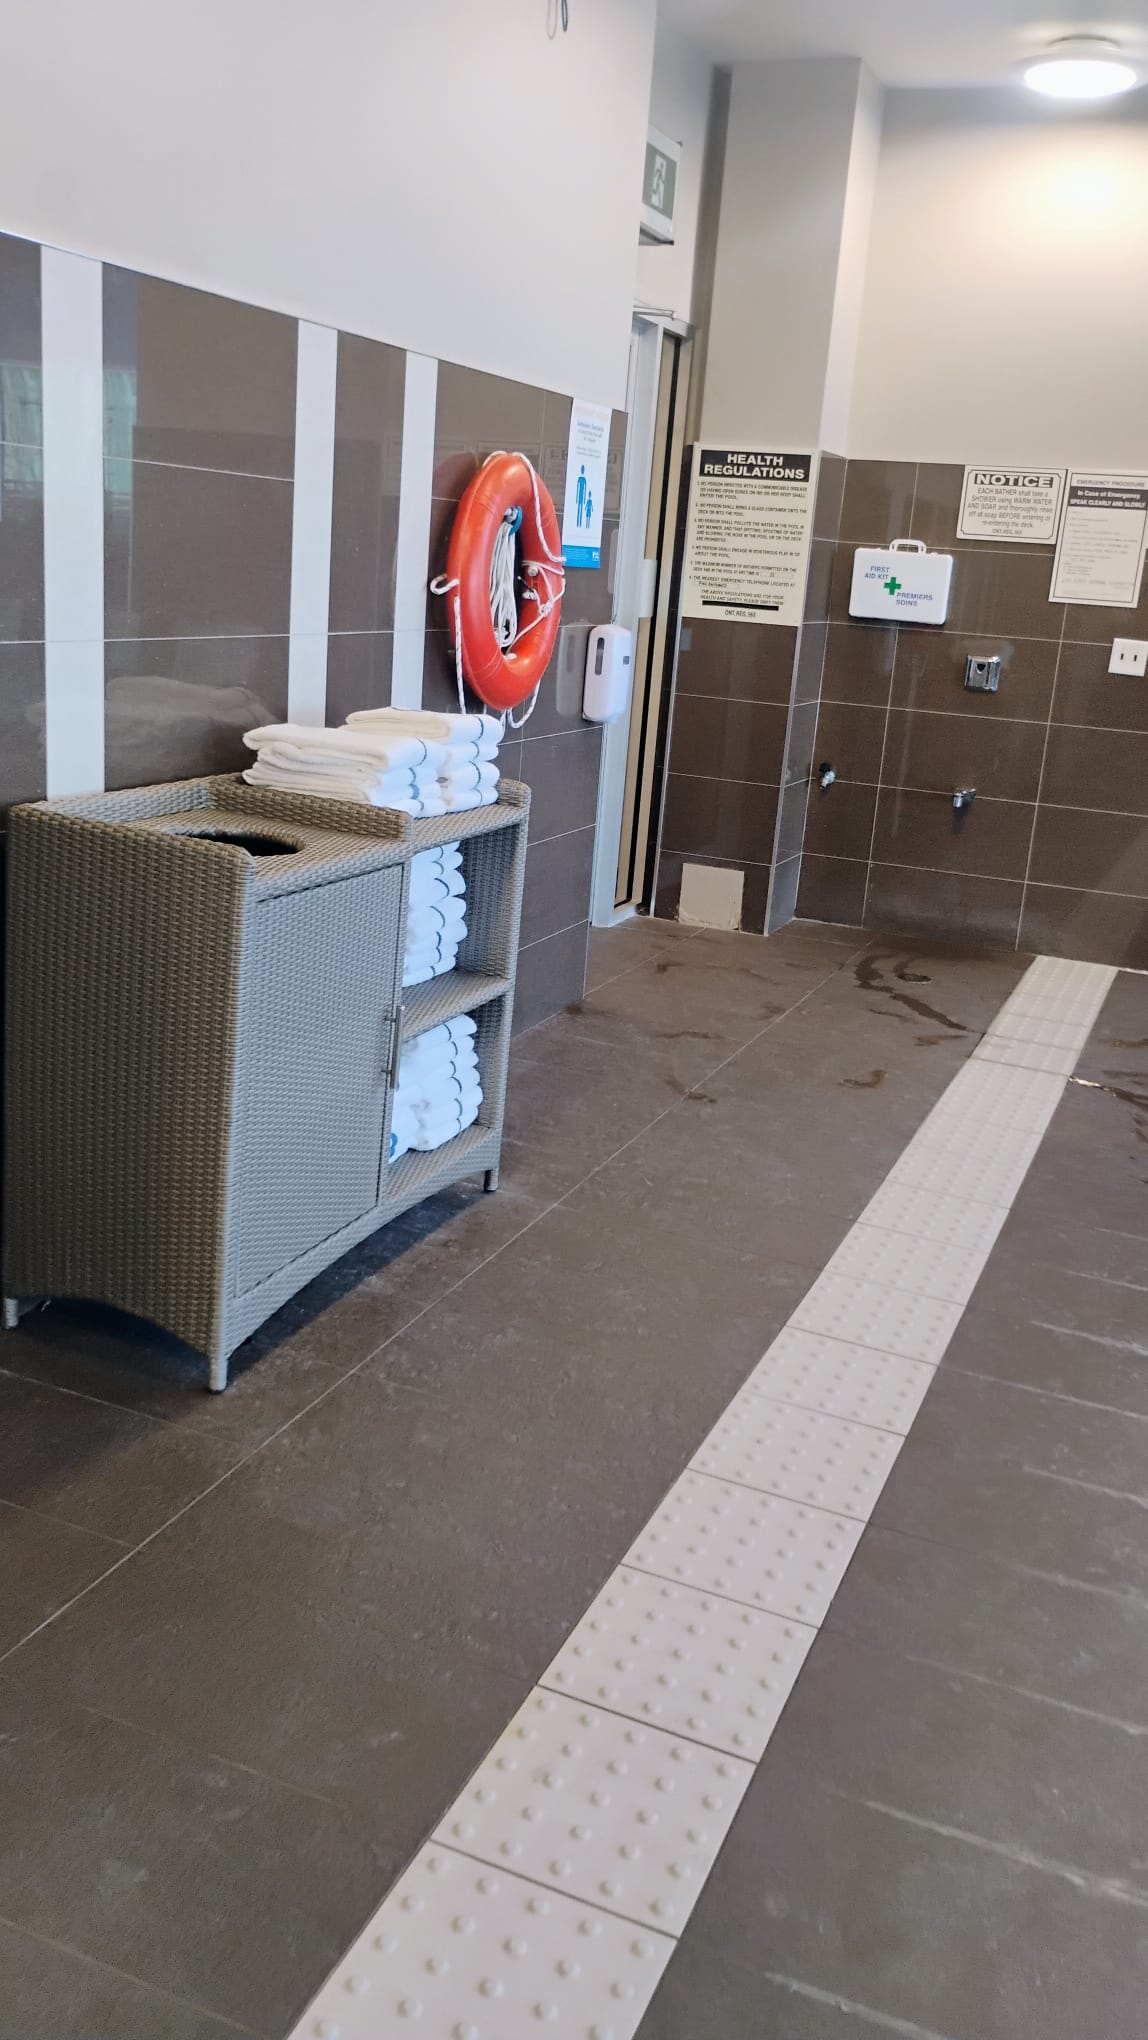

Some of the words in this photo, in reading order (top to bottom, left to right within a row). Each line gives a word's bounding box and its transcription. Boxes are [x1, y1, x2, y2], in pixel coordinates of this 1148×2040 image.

[727, 453, 784, 466] HEALTH
[704, 464, 805, 480] REGULATIONS
[976, 474, 1051, 487] NOTICE
[1107, 491, 1140, 500] Emergency
[864, 572, 876, 580] AID
[896, 592, 933, 601] PREMIERS
